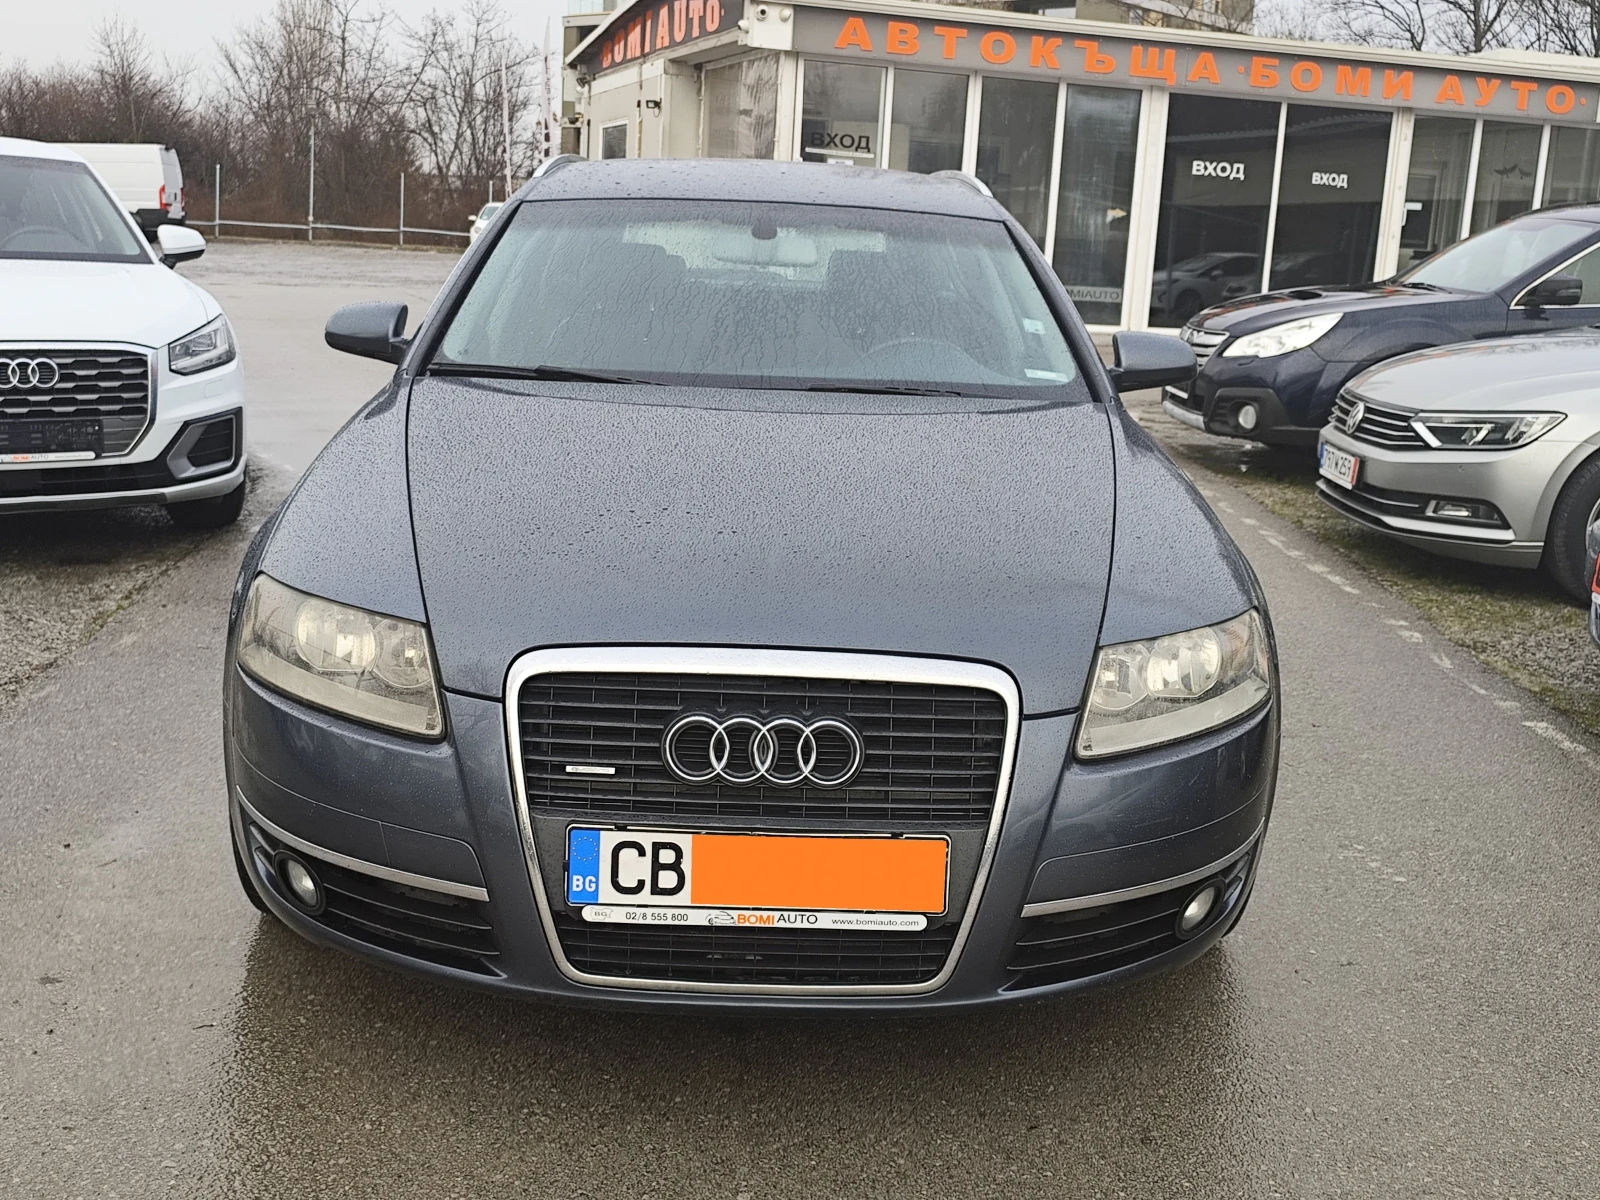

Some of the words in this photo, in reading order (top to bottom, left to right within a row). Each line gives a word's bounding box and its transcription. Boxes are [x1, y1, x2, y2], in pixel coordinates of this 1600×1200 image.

[834, 16, 1221, 86] АВТОКЪЩА
[1249, 56, 1414, 100] БОМИ
[1435, 75, 1576, 115] АУТО
[811, 132, 871, 153] ВХОД
[1191, 160, 1245, 181] ВХОД
[1311, 171, 1348, 189] ВХОД
[610, 840, 686, 896] CB
[572, 874, 597, 892] BG
[625, 911, 648, 921] 02/8
[650, 913, 668, 921] 555
[671, 913, 689, 922] 800
[736, 914, 775, 925] BOMI
[777, 913, 818, 924] AUTO
[831, 917, 920, 927] www.bomiauto.com
